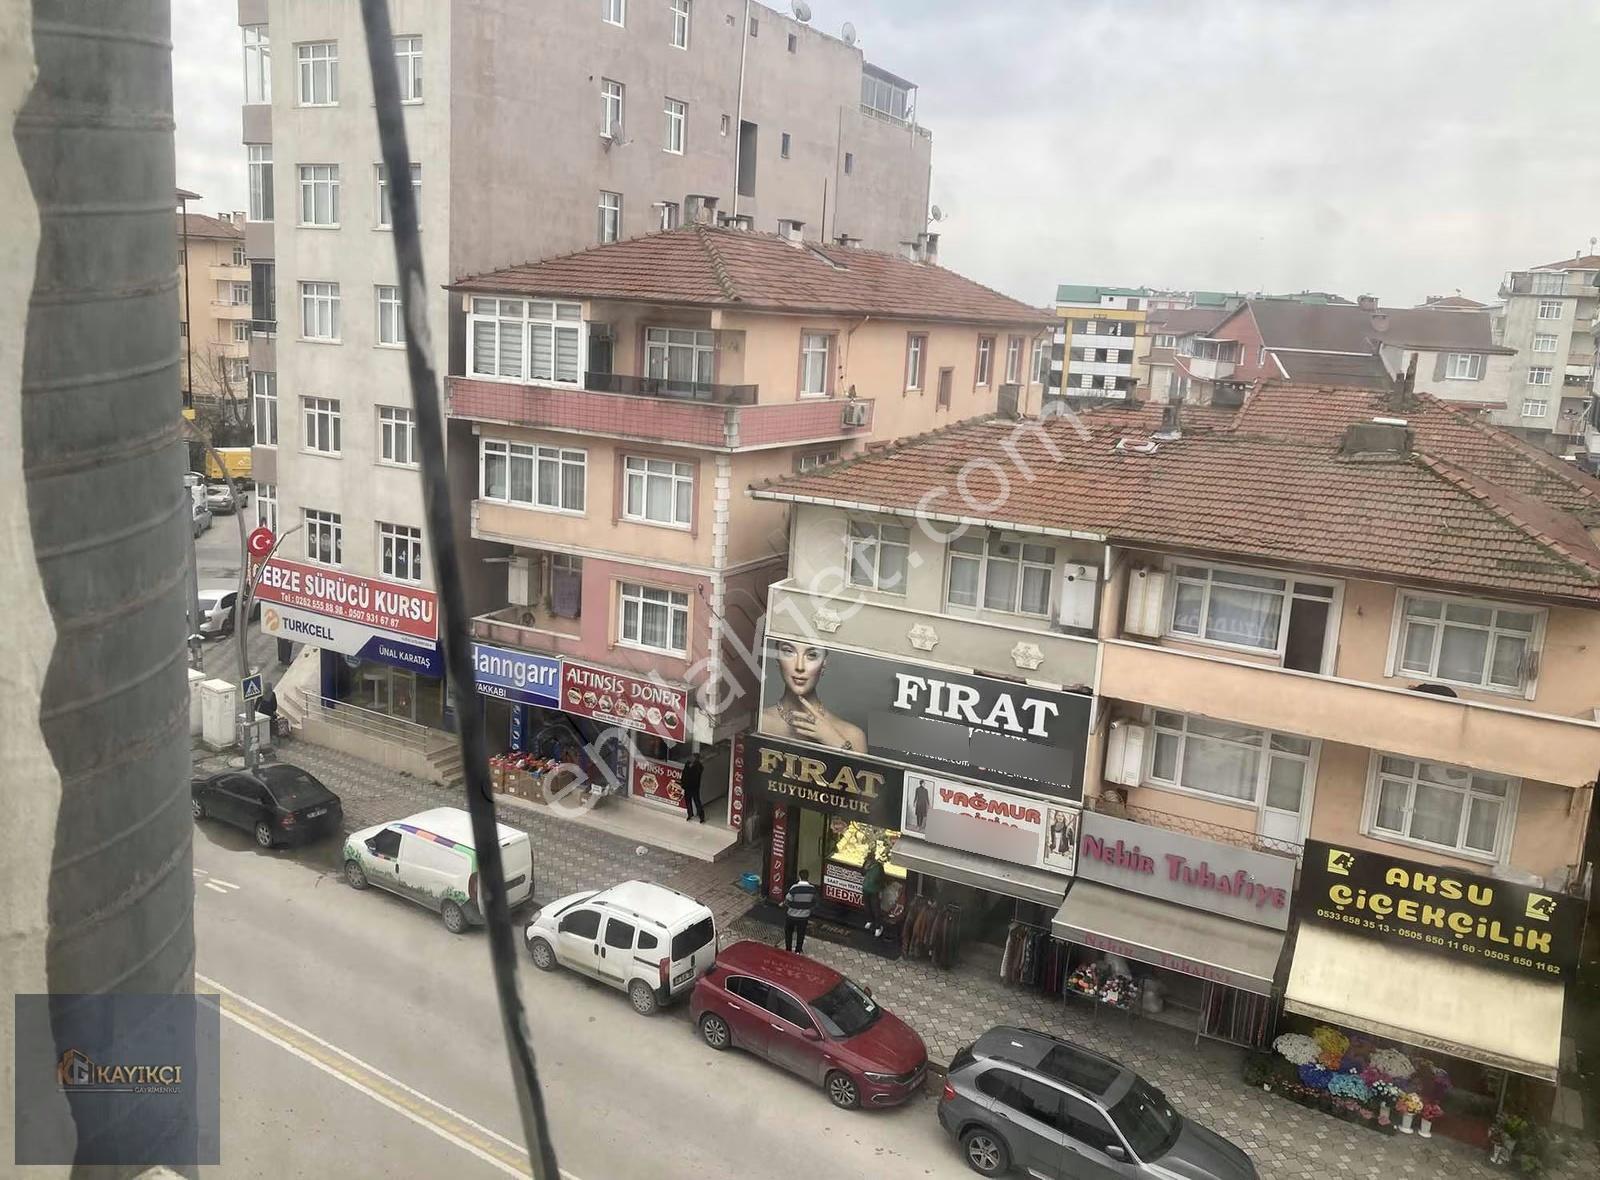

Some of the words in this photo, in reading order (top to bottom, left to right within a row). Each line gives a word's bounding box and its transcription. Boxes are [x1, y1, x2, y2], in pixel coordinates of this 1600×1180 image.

[304, 572, 369, 608] SÜRÜCÜ
[374, 589, 433, 623] KURSU
[282, 617, 335, 641] TURKCELL
[348, 608, 365, 621] 0507
[366, 612, 379, 624] 931
[380, 615, 389, 626] 67
[378, 644, 398, 659] ÜNAL
[399, 651, 431, 669] KARATAŞ
[631, 683, 682, 711] DÖNER
[893, 672, 1060, 738] FIRAT
[757, 747, 886, 799] FIRAT
[767, 780, 871, 815] KUYUMCULUK
[939, 787, 1041, 825] YAĞMUR
[1385, 867, 1494, 906] AKSU
[1317, 908, 1341, 921] 0533
[1342, 914, 1361, 926] 658
[1362, 919, 1376, 930] 35
[1378, 923, 1390, 933] 13
[1398, 928, 1423, 941] 0505
[1425, 934, 1444, 946] 650
[1448, 940, 1459, 949] 11
[1462, 944, 1476, 953] 60
[1484, 949, 1510, 962] 0505
[1328, 884, 1552, 954] ÇİÇEKÇİLİK
